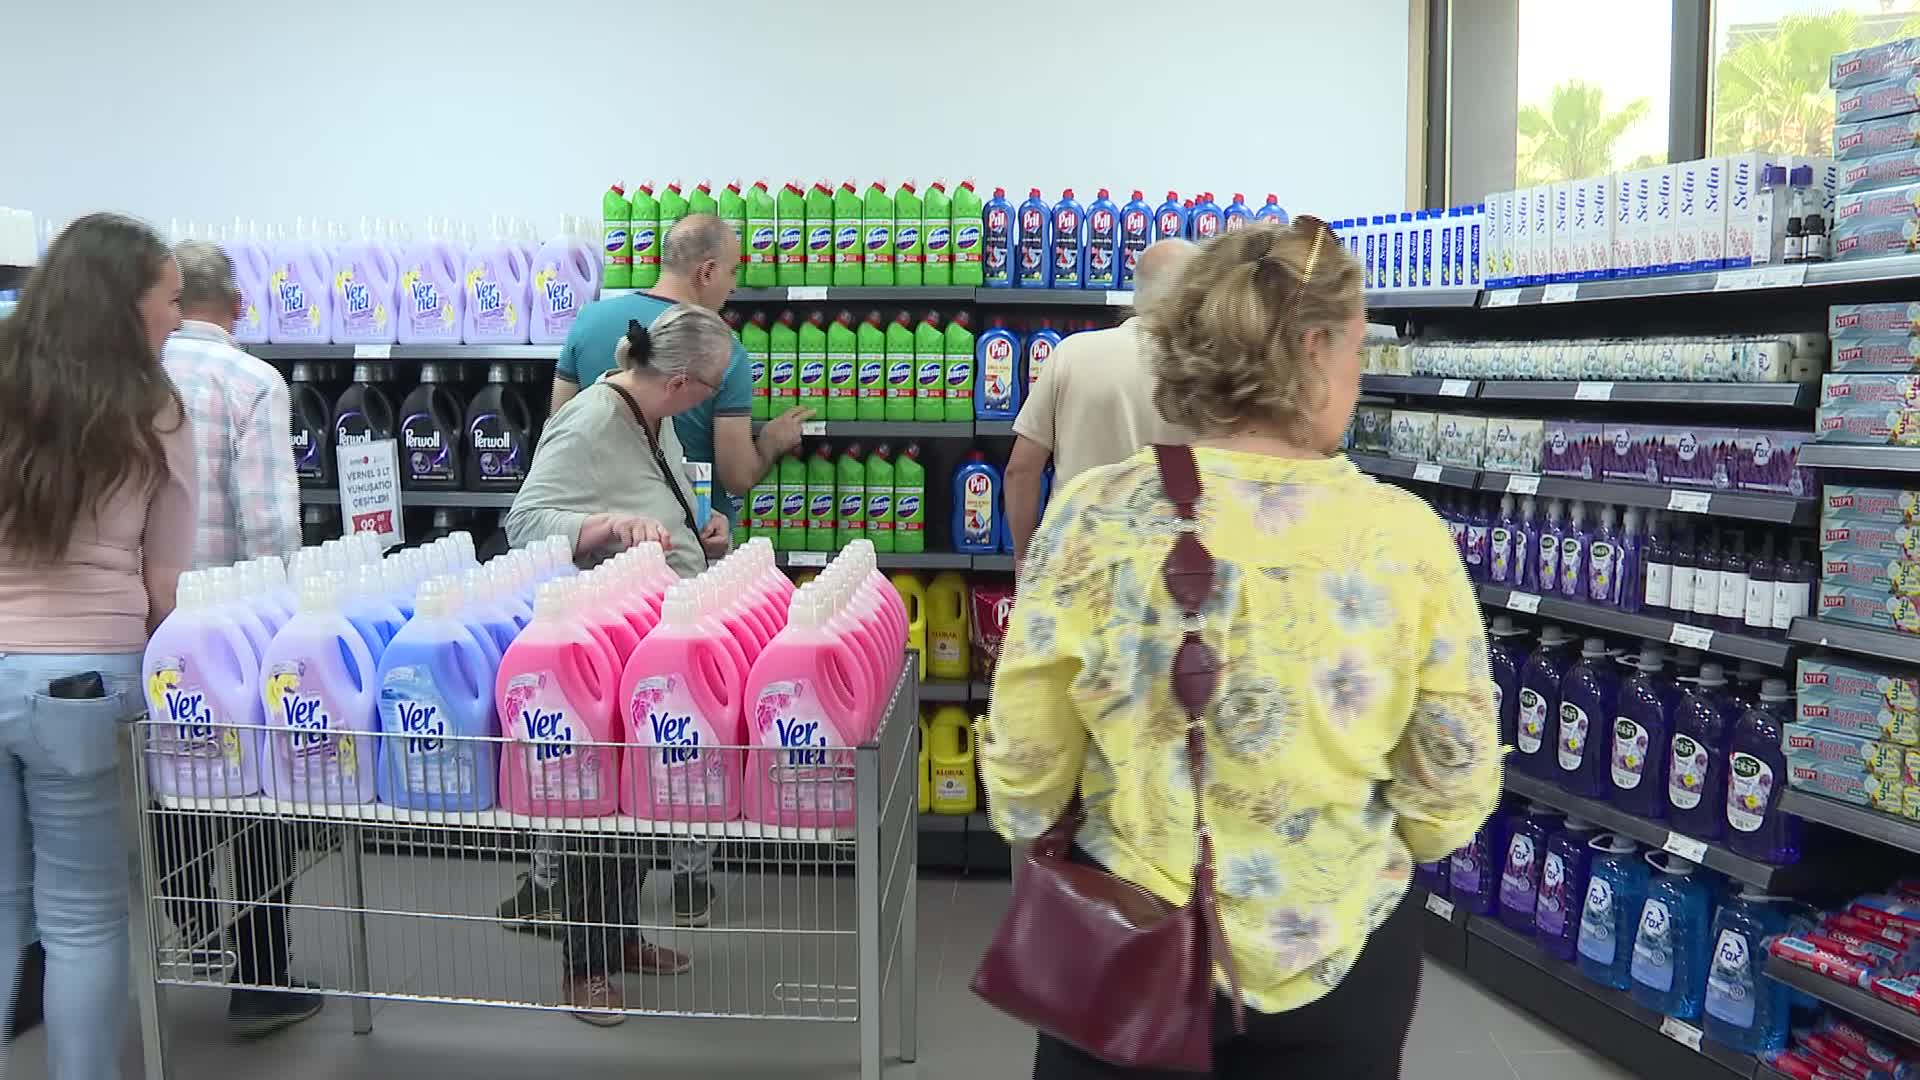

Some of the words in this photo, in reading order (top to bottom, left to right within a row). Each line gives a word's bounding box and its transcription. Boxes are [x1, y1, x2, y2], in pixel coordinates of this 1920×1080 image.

[1681, 171, 1695, 216] Selin
[1705, 167, 1719, 212] Selin
[1734, 163, 1748, 210] Selin
[1824, 167, 1836, 213] Selin
[1594, 185, 1604, 226] Selin
[1619, 182, 1630, 224] Selin
[1637, 179, 1648, 222] Selin
[1658, 175, 1670, 219] Selin
[1536, 194, 1545, 234] Selin
[1556, 191, 1566, 231] Selin
[1576, 188, 1585, 229] Selin
[989, 210, 1005, 230] Pril
[1023, 211, 1040, 230] Pril
[1058, 211, 1075, 230] Pril
[1094, 211, 1111, 230] Pril
[1127, 212, 1144, 231] Pril
[1161, 212, 1178, 231] Pril
[1200, 213, 1216, 233] Pril
[279, 283, 299, 300] Ver
[344, 283, 364, 300] Ver
[412, 283, 433, 300] Ver
[475, 282, 496, 299] Ver
[546, 283, 568, 300] Ver
[284, 293, 303, 312] nel
[350, 293, 369, 312] nel
[417, 293, 437, 311] nel
[480, 293, 500, 311] nel
[552, 293, 573, 311] nel
[992, 343, 1008, 357] Pril
[1033, 343, 1048, 358] Pril
[338, 427, 372, 446] Perwoll
[405, 429, 440, 448] Perwoll
[474, 429, 510, 448] Perwoll
[346, 470, 375, 481] VERNEL
[970, 478, 987, 493] Pril
[1803, 673, 1829, 685] STEPY
[166, 691, 202, 720] Ver
[283, 696, 320, 725] Ver
[1803, 706, 1829, 717] STEPY
[179, 709, 212, 739] nel
[398, 702, 435, 731] Ver
[523, 708, 563, 739] Ver
[293, 714, 328, 747] nel
[409, 721, 444, 754] nel
[650, 712, 691, 744] Ver
[776, 717, 818, 750] Ver
[536, 726, 572, 761] nel
[661, 732, 699, 765] nel
[1790, 737, 1814, 748] STEPY
[788, 737, 826, 770] nel
[1589, 887, 1606, 907] Fax
[1644, 911, 1663, 931] Fax
[1720, 942, 1742, 963] Fax
